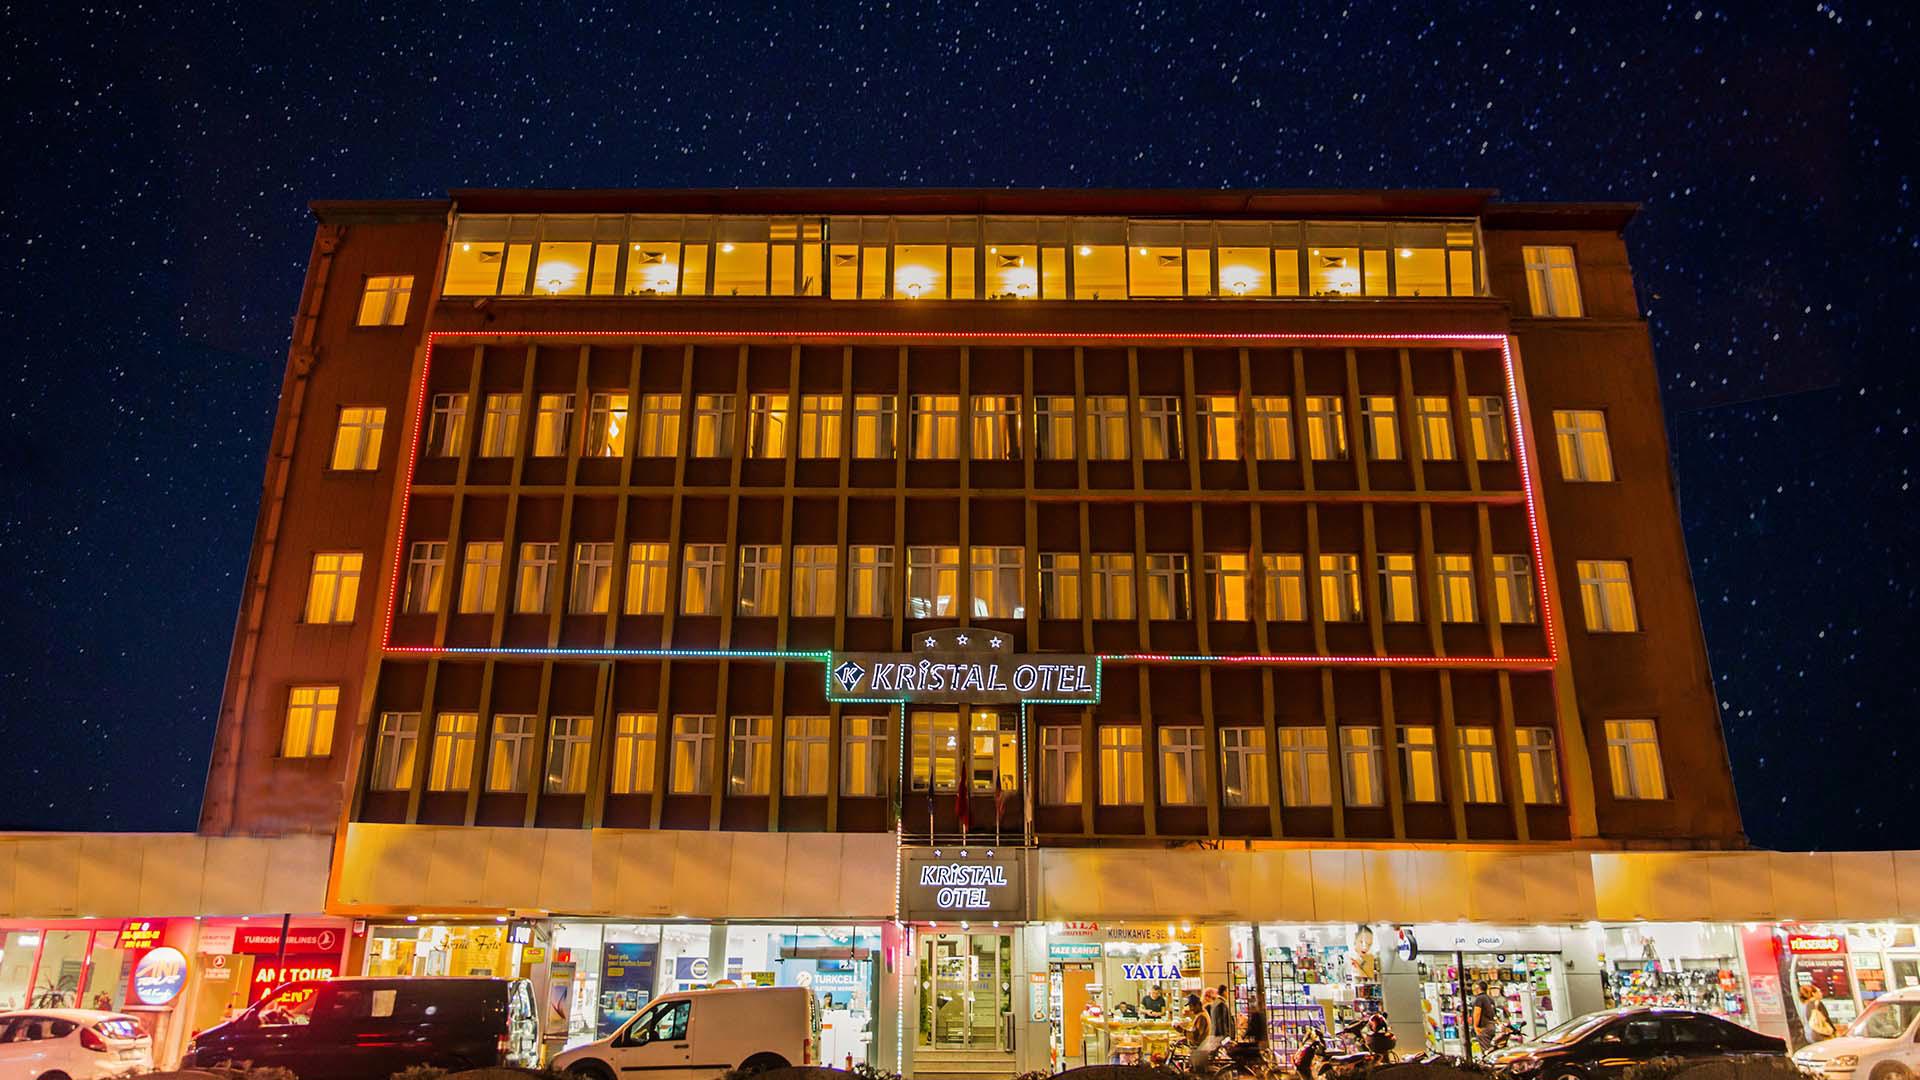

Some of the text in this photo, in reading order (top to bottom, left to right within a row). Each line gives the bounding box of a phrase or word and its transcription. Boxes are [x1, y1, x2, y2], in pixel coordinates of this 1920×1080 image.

[1012, 664, 1093, 692] OTEL
[937, 887, 991, 908] OTEL
[244, 935, 280, 944] TURKISH
[1107, 928, 1151, 939] KURUKAHVE
[290, 968, 333, 982] TOUR
[1122, 964, 1183, 980] YAYLA
